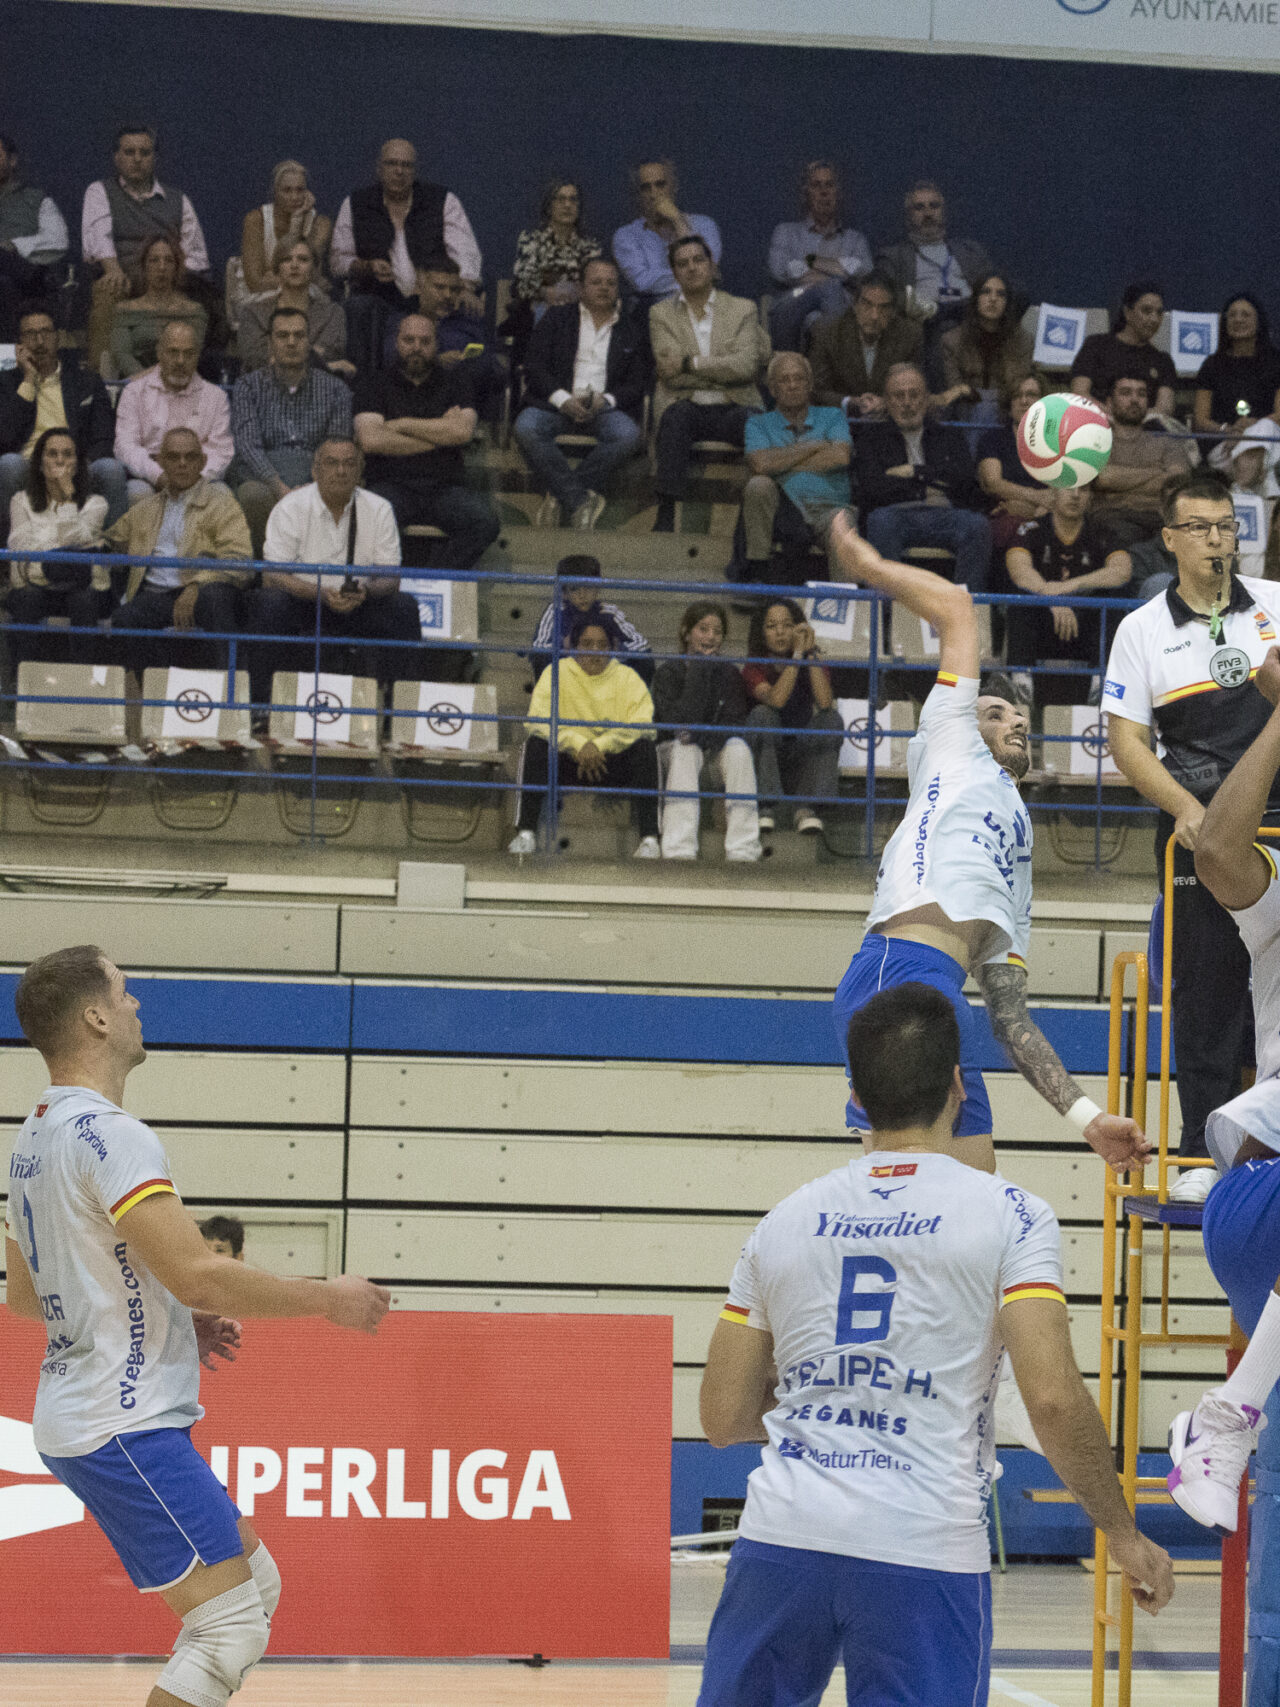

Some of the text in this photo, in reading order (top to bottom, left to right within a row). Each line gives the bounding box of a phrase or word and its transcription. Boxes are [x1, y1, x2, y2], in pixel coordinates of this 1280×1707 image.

[1217, 657, 1242, 671] FIVB
[813, 1211, 943, 1239] Ynsadiet
[114, 1242, 145, 1410] cveganes.com
[835, 1255, 897, 1346] 6
[904, 1368, 938, 1400] H.
[210, 1446, 572, 1520] PERLIGA
